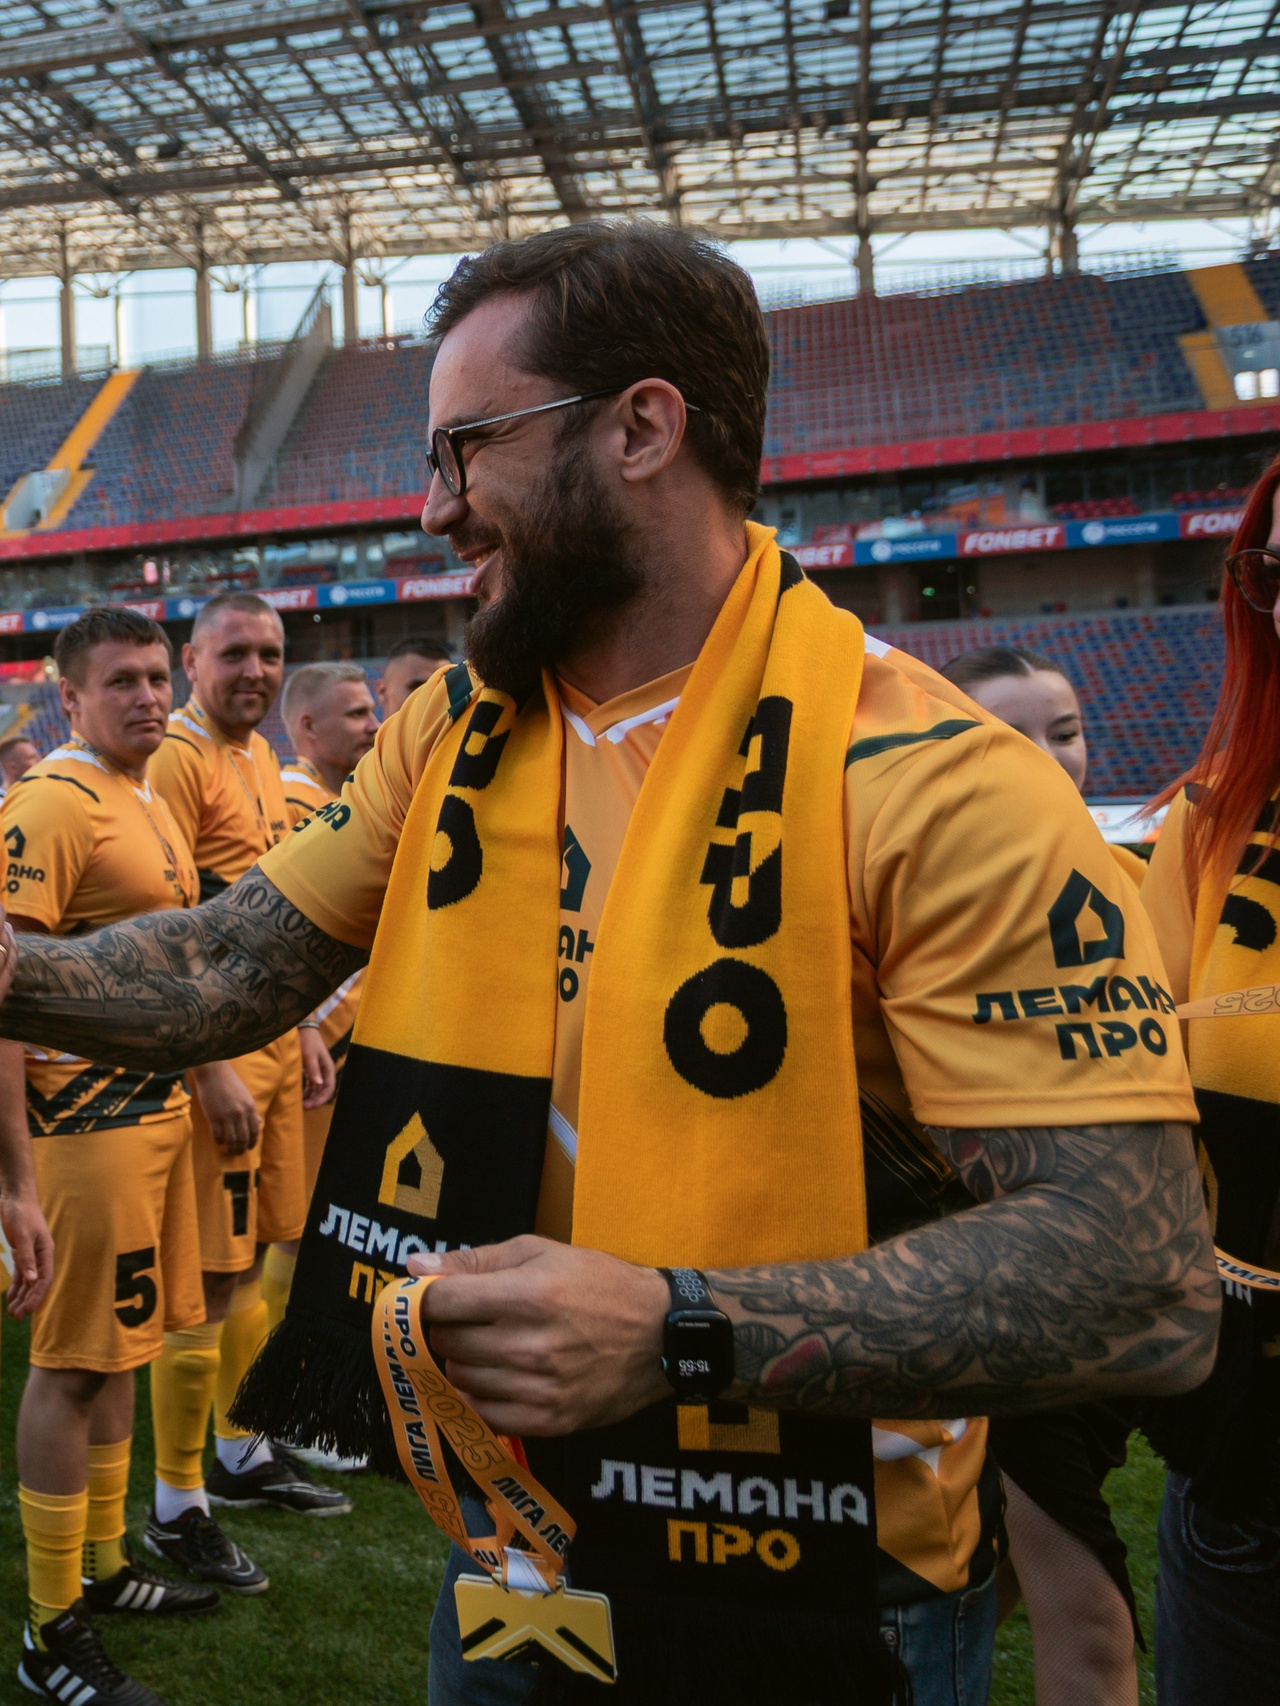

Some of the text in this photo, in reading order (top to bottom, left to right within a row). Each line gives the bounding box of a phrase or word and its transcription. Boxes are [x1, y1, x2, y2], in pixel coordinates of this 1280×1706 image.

[964, 527, 1061, 554] FONBET
[1188, 512, 1245, 535] FON
[789, 545, 847, 567] NBET
[258, 589, 312, 608] NBET
[6, 863, 46, 883] АНА
[1213, 984, 1280, 1015] 25
[1055, 1017, 1168, 1061] ПРО
[224, 1170, 261, 1236] 1
[319, 1203, 471, 1267] ЛЕМА
[114, 1247, 156, 1328] 5
[393, 1295, 418, 1358] ПРО
[678, 1359, 711, 1373] 15:55
[405, 1367, 507, 1473] 2025
[404, 1420, 442, 1485] ЛИГА
[490, 1476, 547, 1530] ЛИГА
[591, 1458, 869, 1527] ЛЕМАНА
[666, 1518, 802, 1572] ПРО
